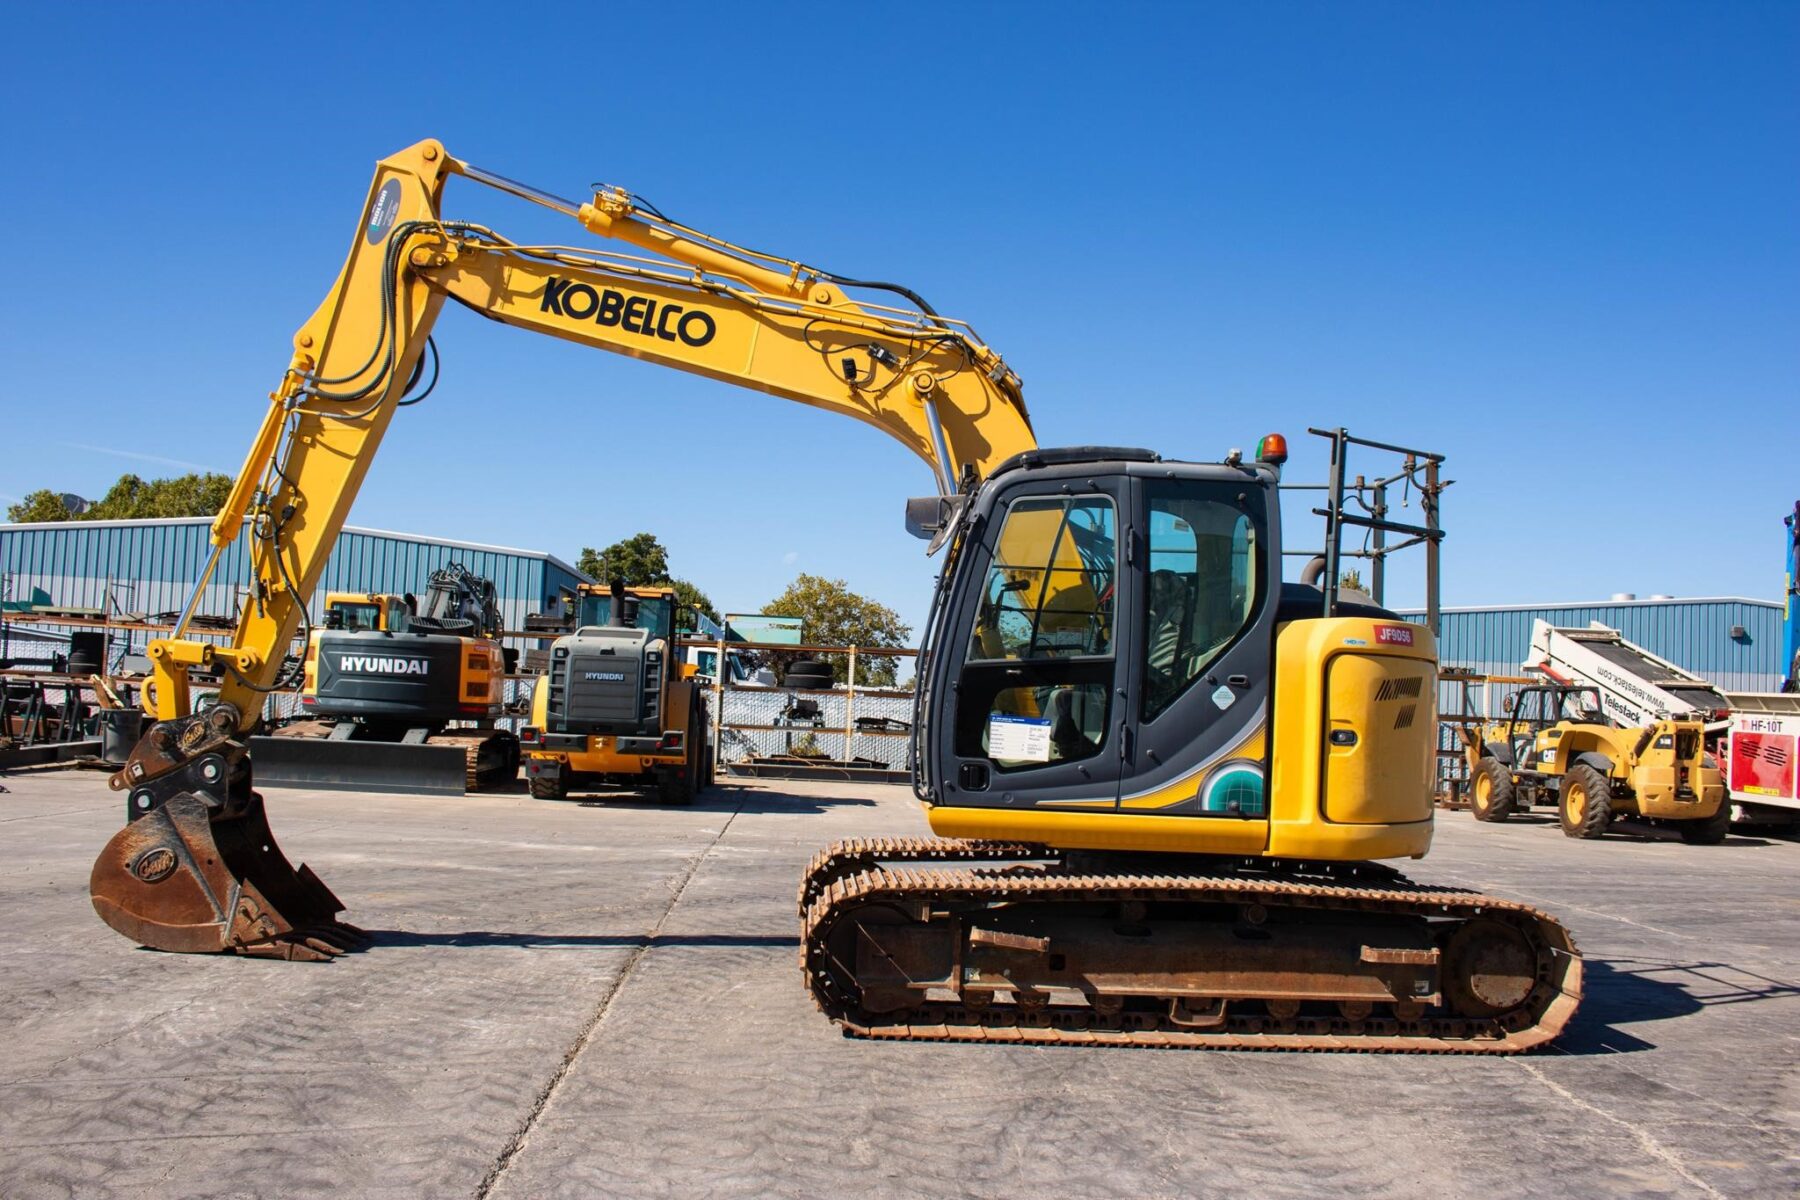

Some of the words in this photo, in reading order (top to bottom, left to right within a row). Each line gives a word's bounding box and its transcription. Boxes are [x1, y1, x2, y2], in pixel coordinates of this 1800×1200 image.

[540, 276, 716, 347] KOBELCO
[340, 656, 429, 675] HYUNDAI
[585, 672, 624, 681] HYUNDAI
[1604, 693, 1641, 725] Telestack
[1751, 720, 1783, 732] HF-10T
